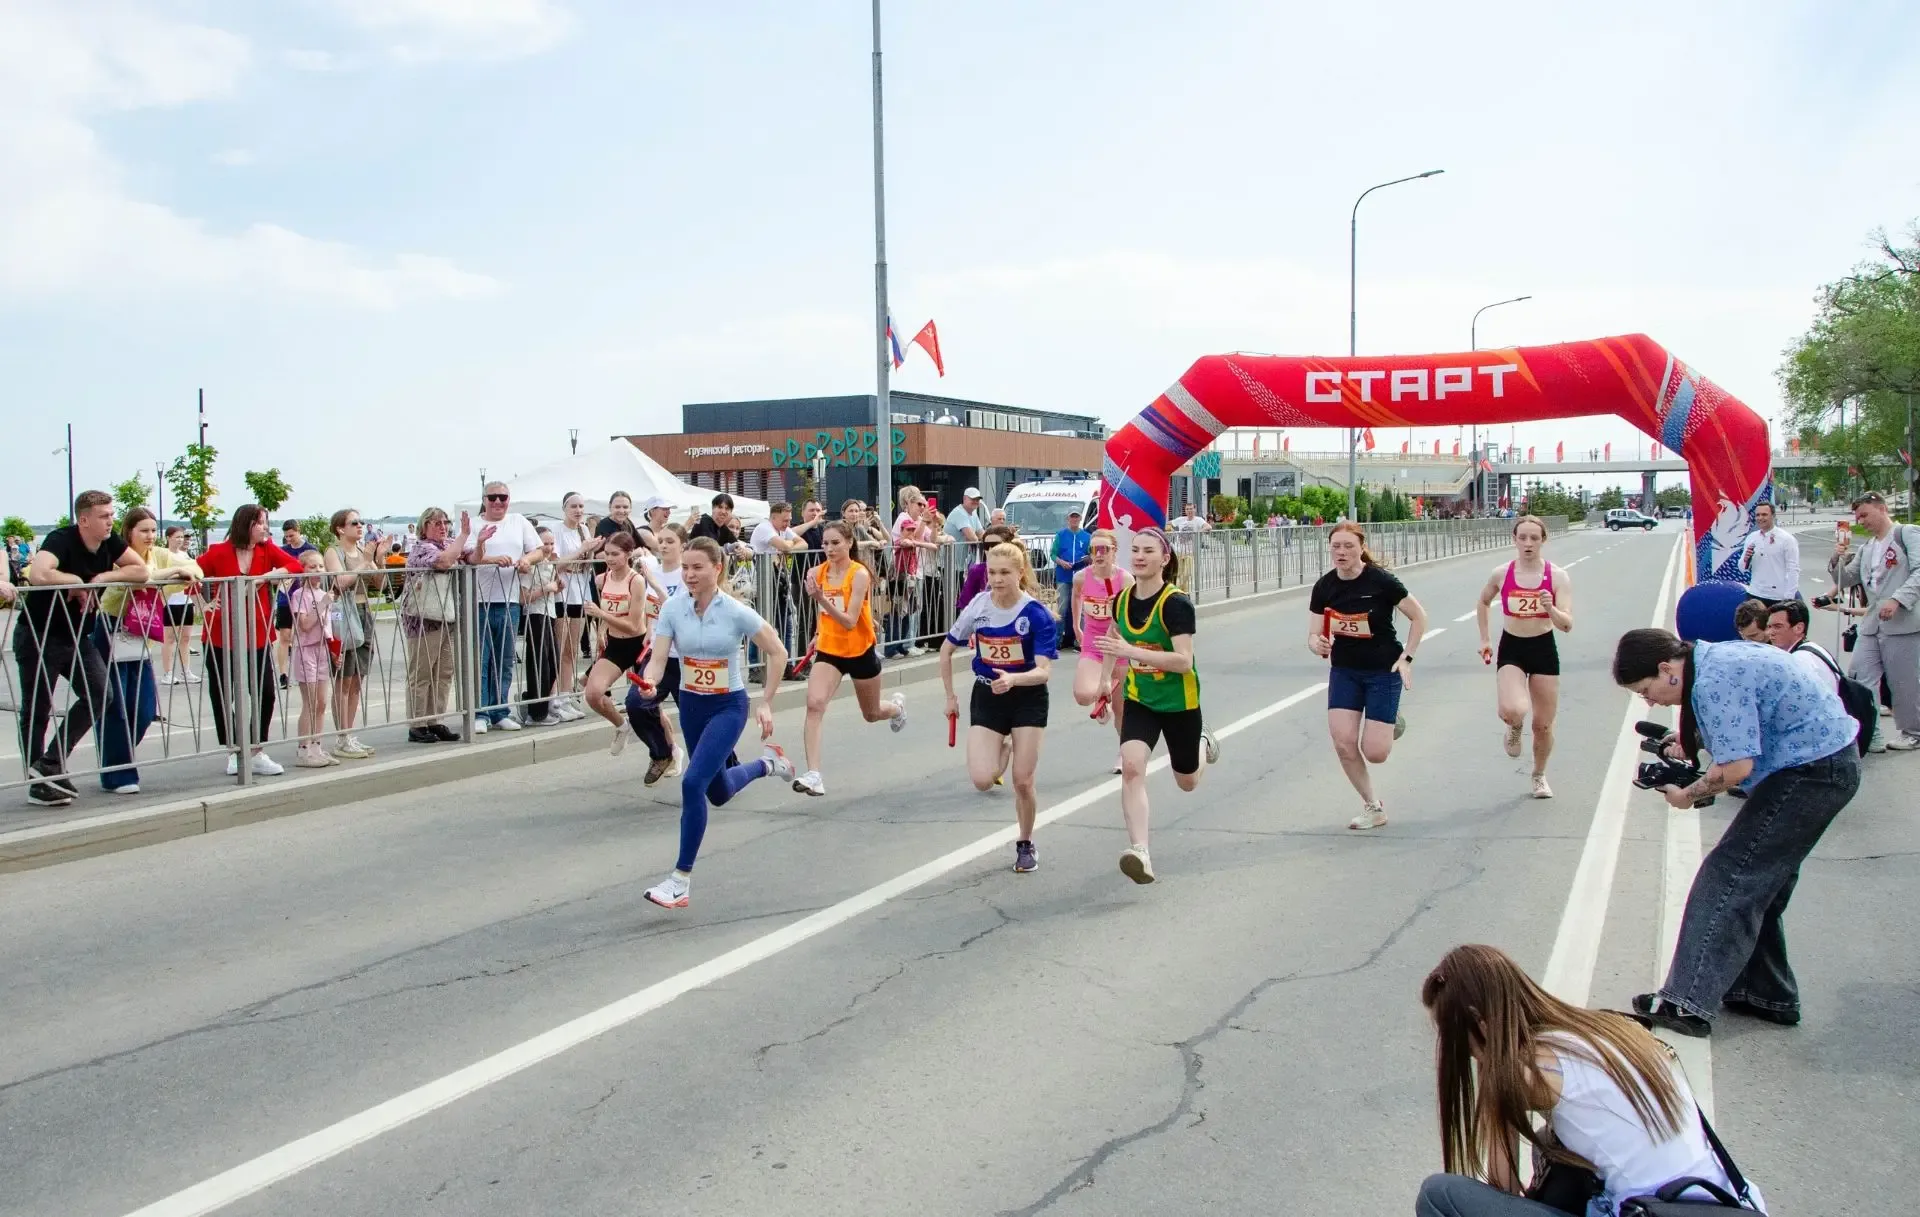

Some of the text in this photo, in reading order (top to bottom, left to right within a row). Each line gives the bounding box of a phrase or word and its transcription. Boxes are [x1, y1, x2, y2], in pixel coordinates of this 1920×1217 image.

[1305, 364, 1517, 402] СТАРТ
[688, 444, 766, 459] грузинский ресторан
[607, 601, 620, 612] 27
[1092, 603, 1107, 616] 31
[1518, 598, 1538, 612] 24
[1338, 621, 1359, 633] 25
[989, 645, 1011, 659] 28
[694, 669, 716, 686] 29
